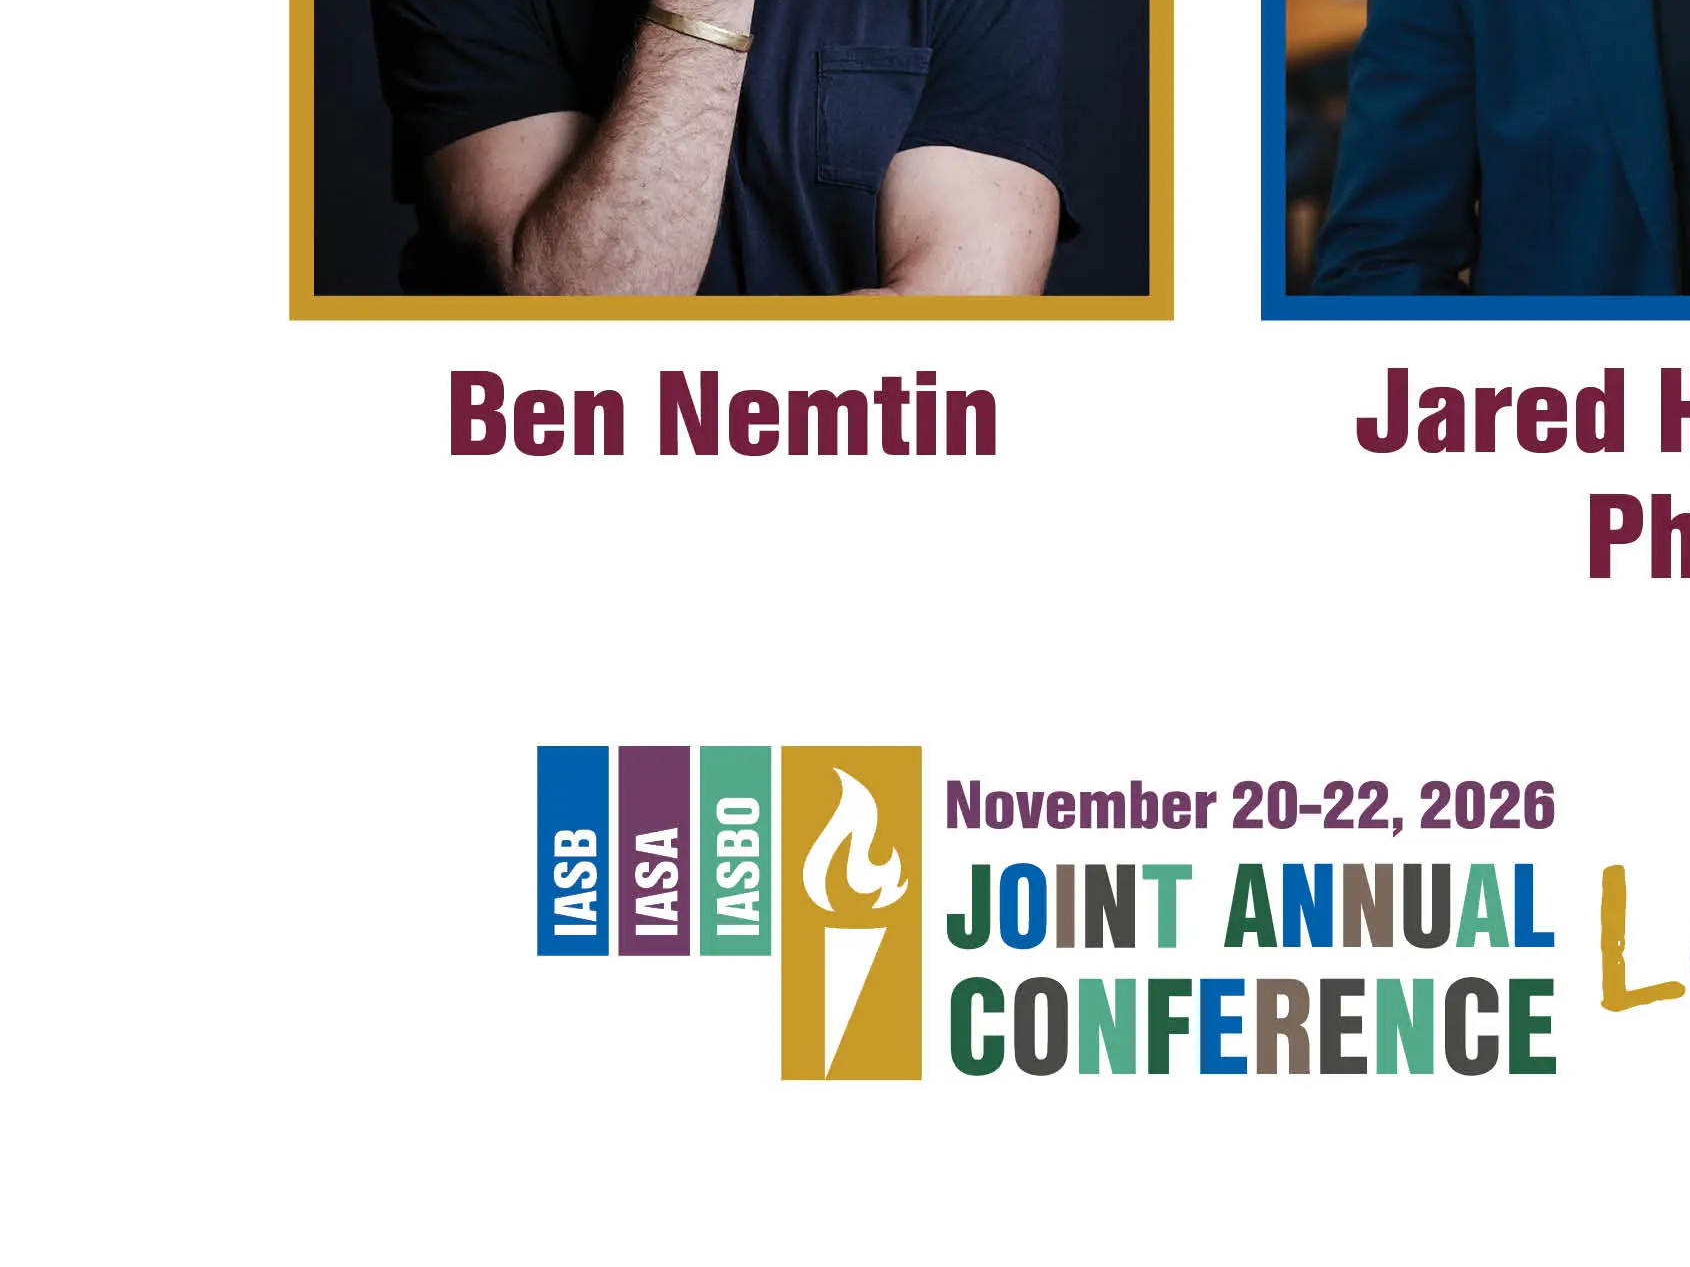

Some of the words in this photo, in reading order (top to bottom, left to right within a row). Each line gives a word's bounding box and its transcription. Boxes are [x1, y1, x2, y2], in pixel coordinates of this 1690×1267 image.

[451, 371, 624, 456] Ben
[660, 371, 996, 456] Nemtin
[1357, 368, 1624, 453] Jared
[947, 780, 1216, 829] November
[1233, 781, 1403, 837] 20-22,
[1421, 781, 1554, 829] 2026
[554, 830, 597, 935] IASB
[635, 828, 678, 935] IASA
[717, 798, 759, 935] IASBO
[947, 863, 1192, 949] JOINT
[1224, 864, 1554, 948] ANNUAL
[951, 977, 1556, 1076] CONFERENCE
